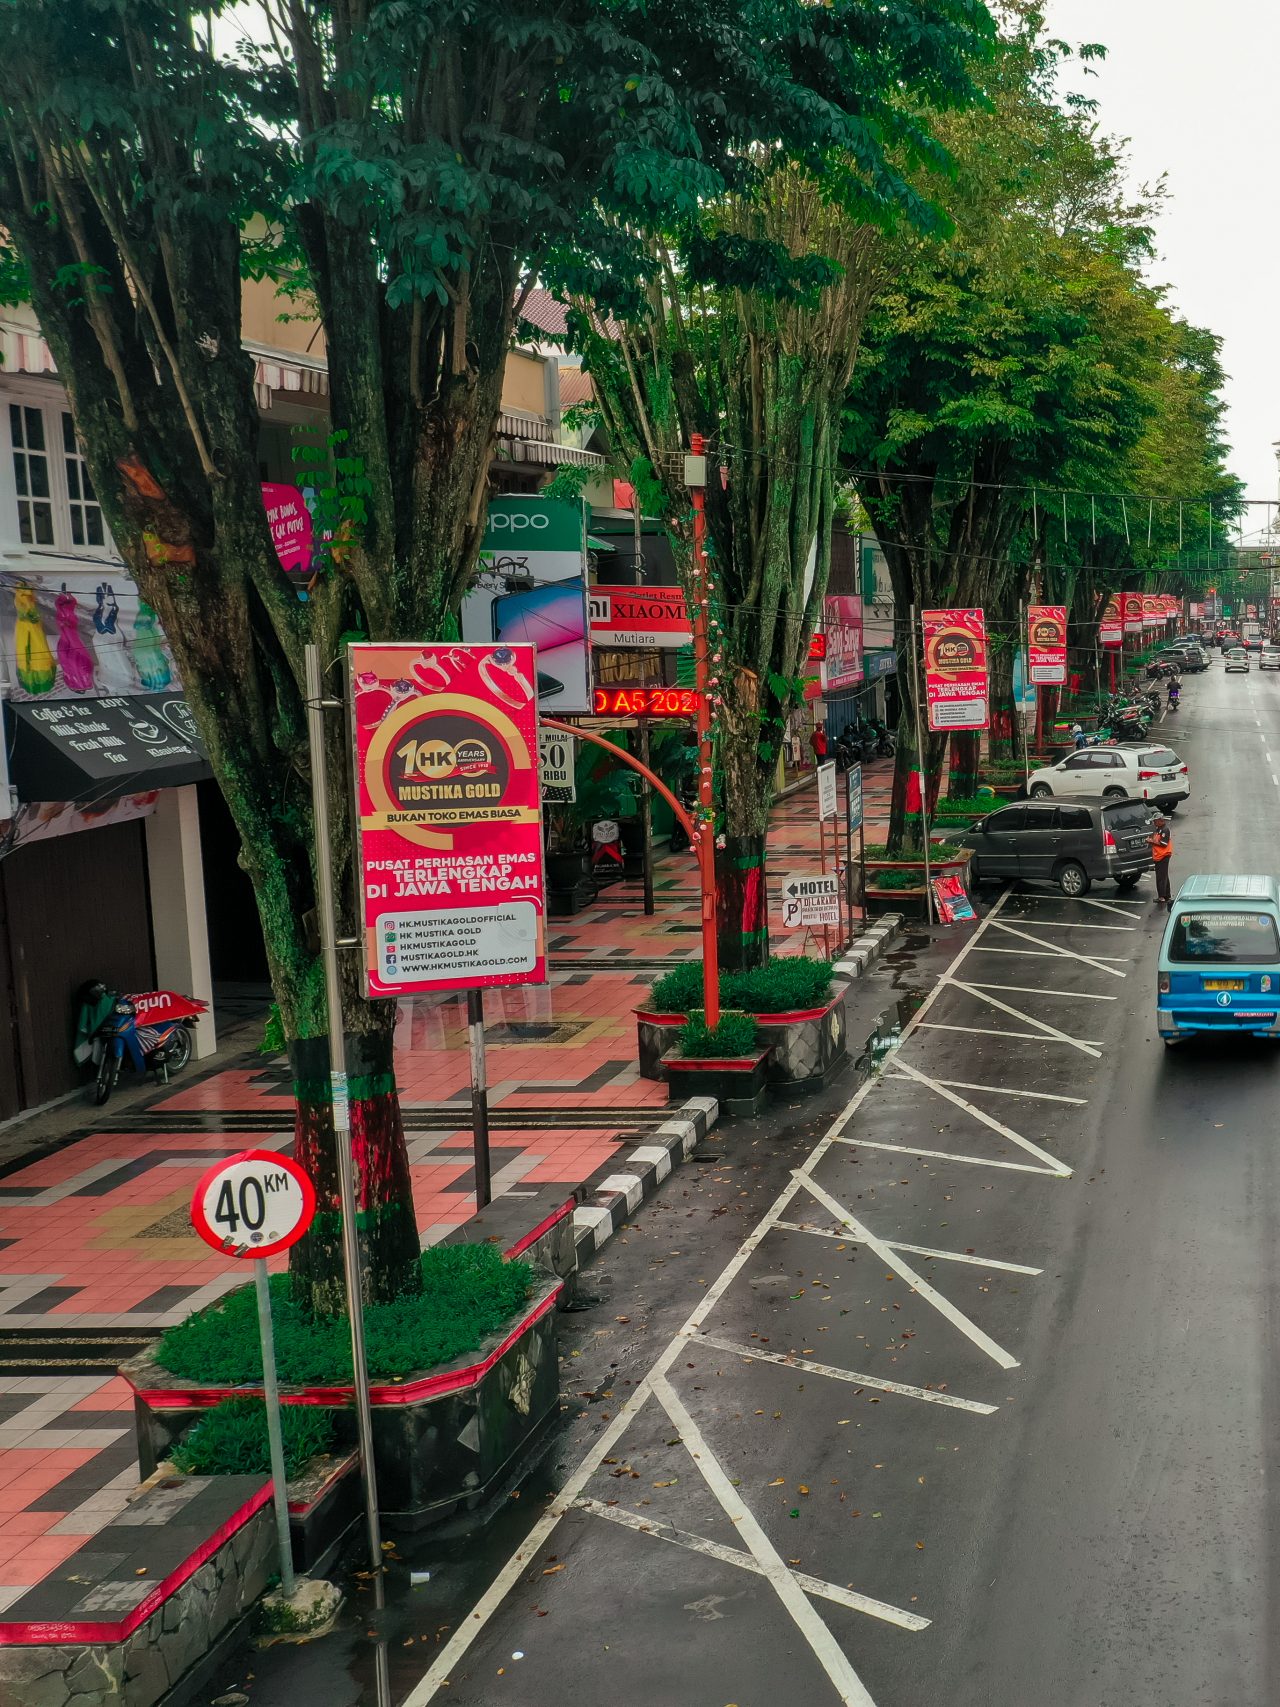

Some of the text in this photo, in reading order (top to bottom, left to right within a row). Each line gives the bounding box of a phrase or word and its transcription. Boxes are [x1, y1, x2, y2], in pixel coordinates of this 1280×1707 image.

[486, 513, 550, 533] ppo
[659, 591, 684, 601] Resm
[614, 633, 656, 644] Mutiara
[97, 698, 130, 709] KOPI
[651, 692, 699, 712] 202
[31, 706, 65, 723] Coffee
[73, 704, 93, 717] Ice
[49, 720, 111, 737] Milk Shake
[68, 735, 127, 752] Fresh Milk
[103, 751, 128, 764] Tea
[420, 751, 453, 767] HK
[457, 750, 485, 758] YEARS
[459, 763, 477, 772] SINCE
[543, 770, 567, 780] RIBU
[398, 783, 501, 801] MUSTIKA GOLD
[387, 808, 522, 823] BUKAN TOKO EMAS BIASA
[366, 853, 536, 871] PUSAT PERHIASAN EMAS
[393, 864, 512, 883] TERLENGKAP
[366, 875, 538, 899] DI JAWA TENGAH
[799, 880, 838, 896] HOTEL
[787, 903, 799, 922] P
[819, 911, 839, 922] HOTEL
[398, 914, 517, 929] HK.MUSTIKAGOLDOFFICIAL
[399, 927, 482, 940] HK MUSTIKA GOLD
[400, 938, 477, 951] HKMUSTIKAGOLD
[400, 949, 480, 962] MUSTIKAGOLD.HK
[401, 956, 528, 973] WWW.HKMUSTIKAGOLD.COM
[214, 1172, 289, 1233] 40 KM
